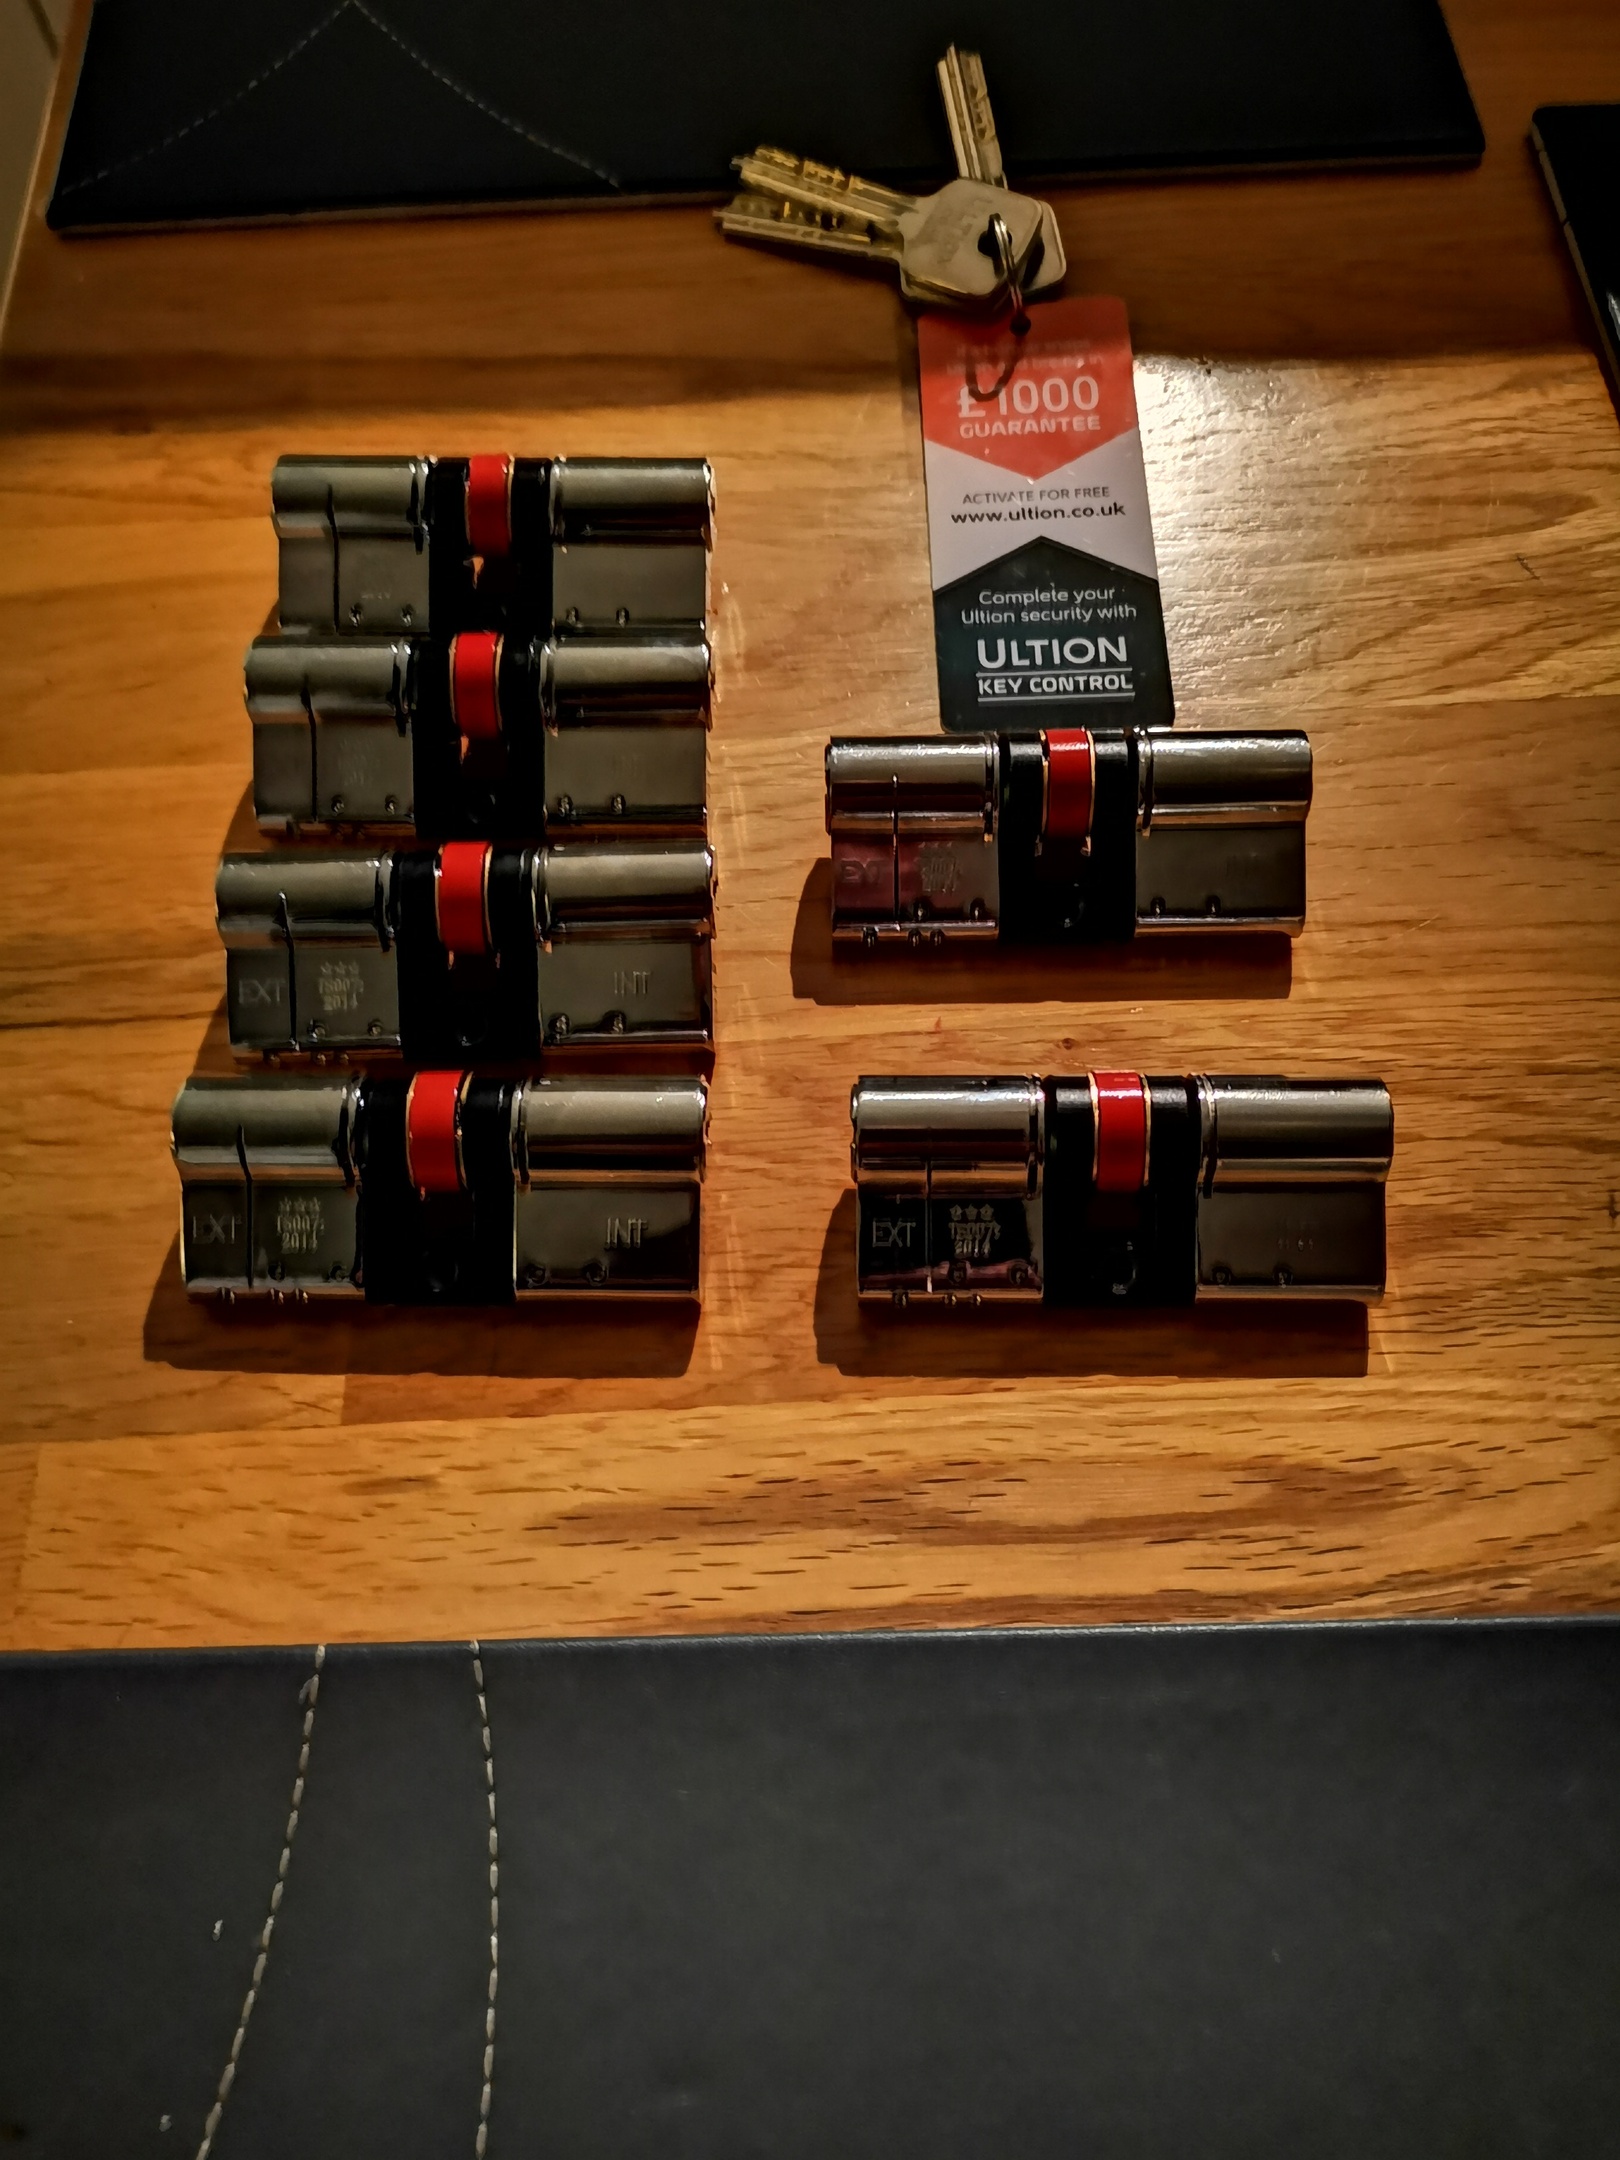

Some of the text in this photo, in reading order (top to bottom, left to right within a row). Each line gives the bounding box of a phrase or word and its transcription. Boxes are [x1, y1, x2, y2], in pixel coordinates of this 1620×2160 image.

[957, 376, 1100, 418] £1000
[958, 415, 1101, 439] GUARANTEE
[962, 486, 1110, 505] ACTIVATE FOR FREE
[951, 502, 1126, 523] www.ultion.co.uk
[978, 586, 1116, 606] Complete your
[961, 604, 1138, 625] Ultion security with
[977, 635, 1128, 669] ULTION
[977, 673, 1134, 695] KEY CONTROL
[872, 1217, 917, 1247] EXT
